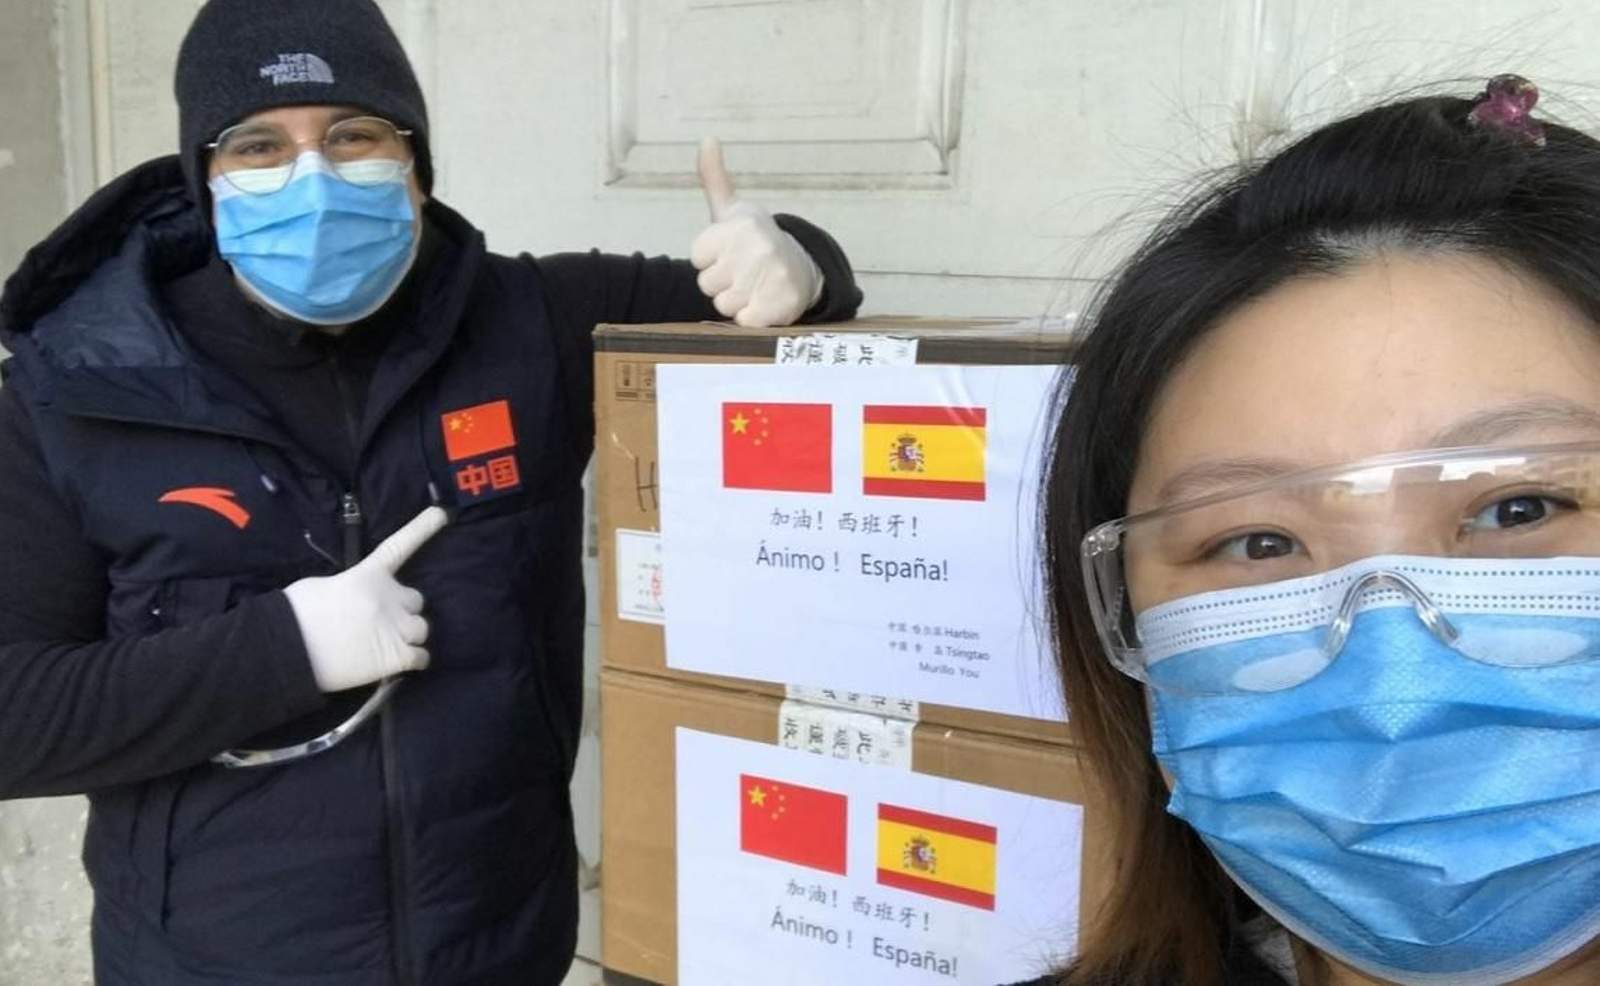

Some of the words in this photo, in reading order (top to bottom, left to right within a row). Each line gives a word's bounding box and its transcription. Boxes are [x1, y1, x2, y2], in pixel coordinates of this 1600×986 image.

[456, 455, 520, 495] 中国
[860, 553, 948, 582] España!
[944, 627, 980, 640] Harbin
[945, 646, 990, 661] Tsingtao
[959, 668, 980, 678] You
[872, 937, 958, 978] España!
